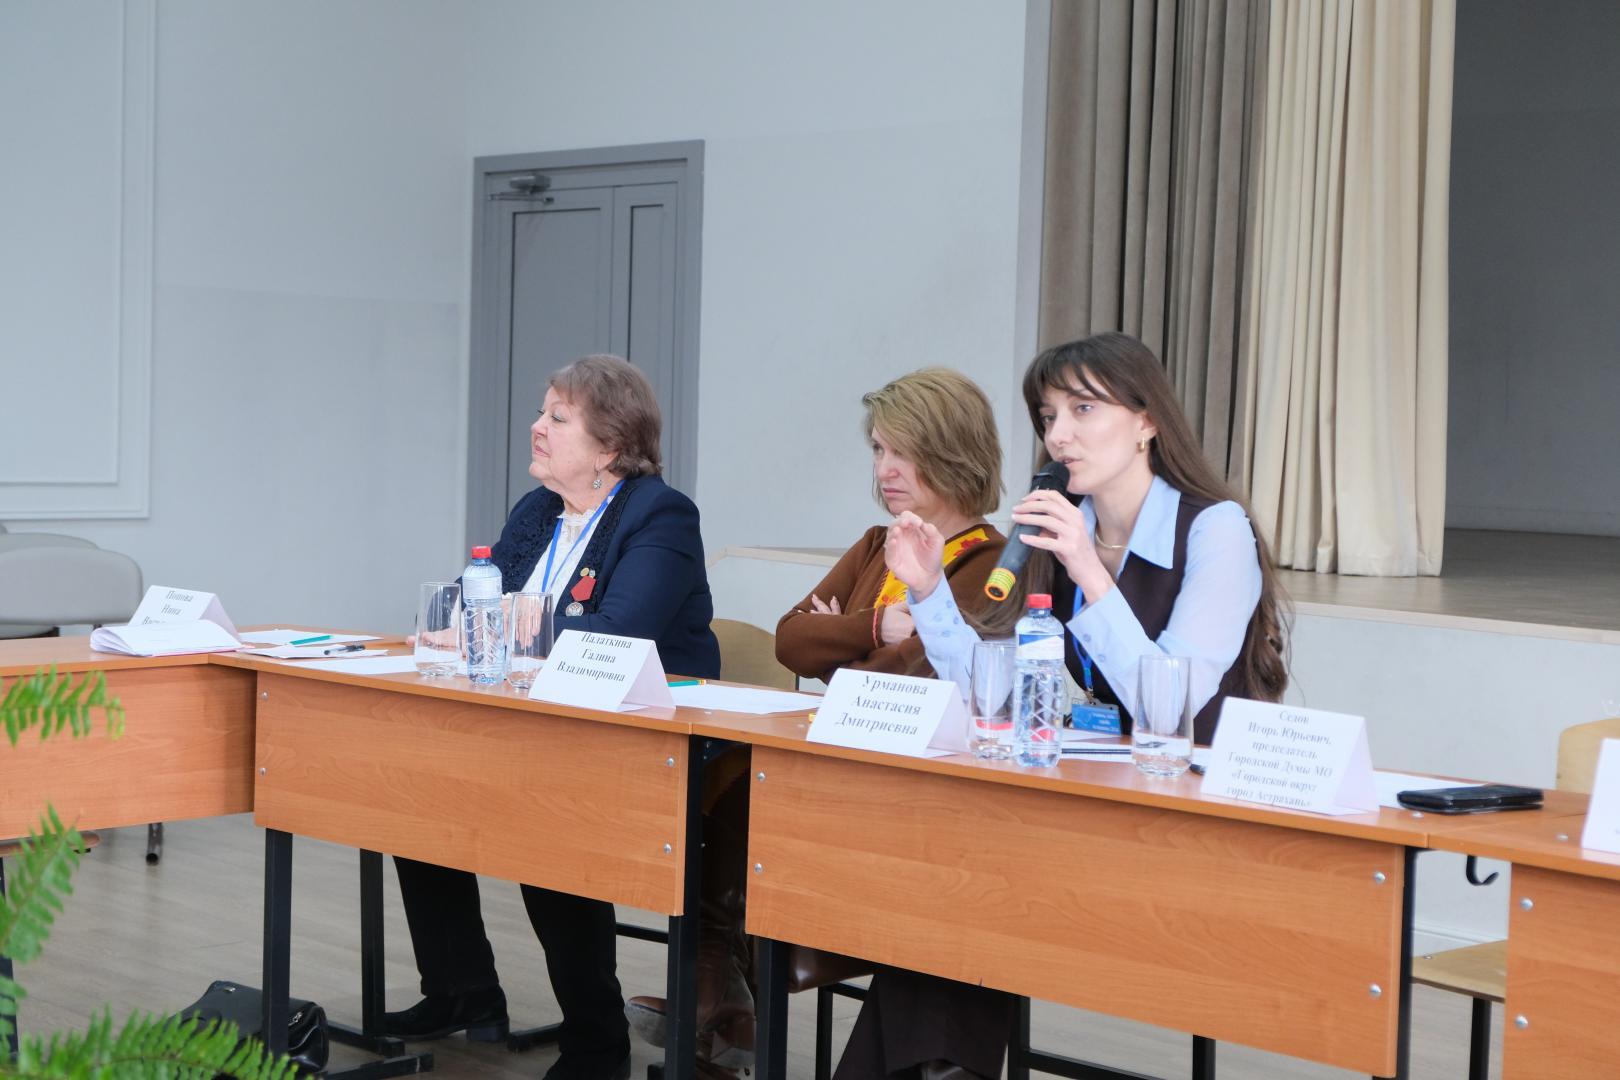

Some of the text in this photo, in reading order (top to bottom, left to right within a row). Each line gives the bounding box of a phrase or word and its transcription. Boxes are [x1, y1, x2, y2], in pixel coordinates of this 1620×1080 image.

[581, 632, 632, 649] Палаткина
[582, 648, 616, 663] Галина
[557, 661, 626, 682] Владимировна
[862, 675, 928, 695] Урманова
[851, 696, 922, 715] Анастасия
[835, 712, 918, 735] Дмитриевна
[1315, 765, 1333, 778] МО
